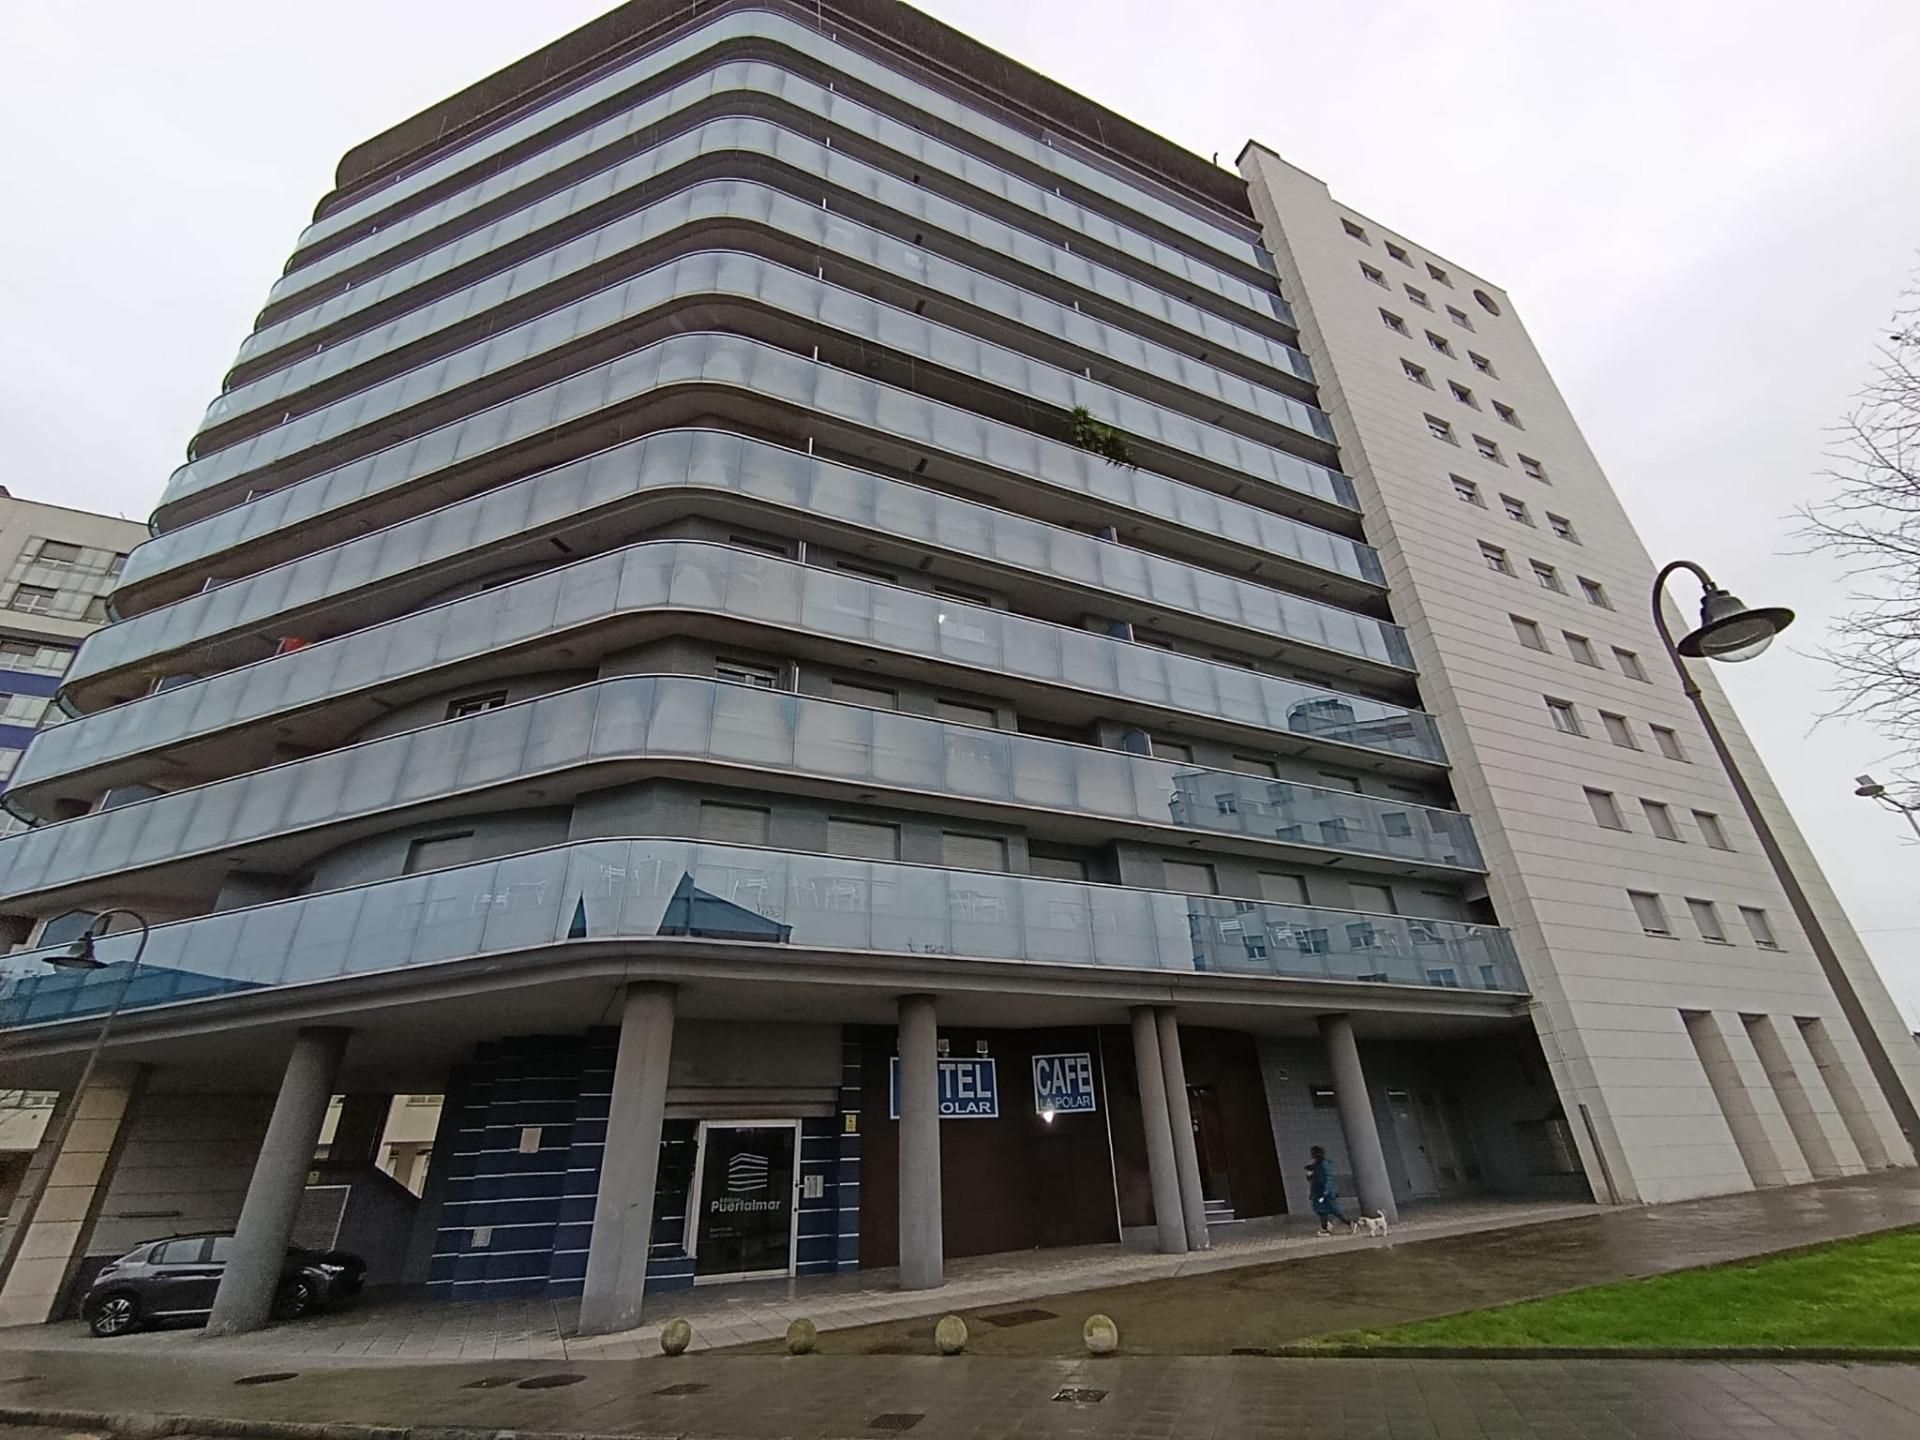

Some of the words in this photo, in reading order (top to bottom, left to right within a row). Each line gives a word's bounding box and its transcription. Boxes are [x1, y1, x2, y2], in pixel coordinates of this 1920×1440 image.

[939, 1063, 992, 1098] TEL
[1036, 1057, 1091, 1095] CAFE
[940, 1102, 991, 1113] OLAR
[1055, 1096, 1091, 1108] POLAR
